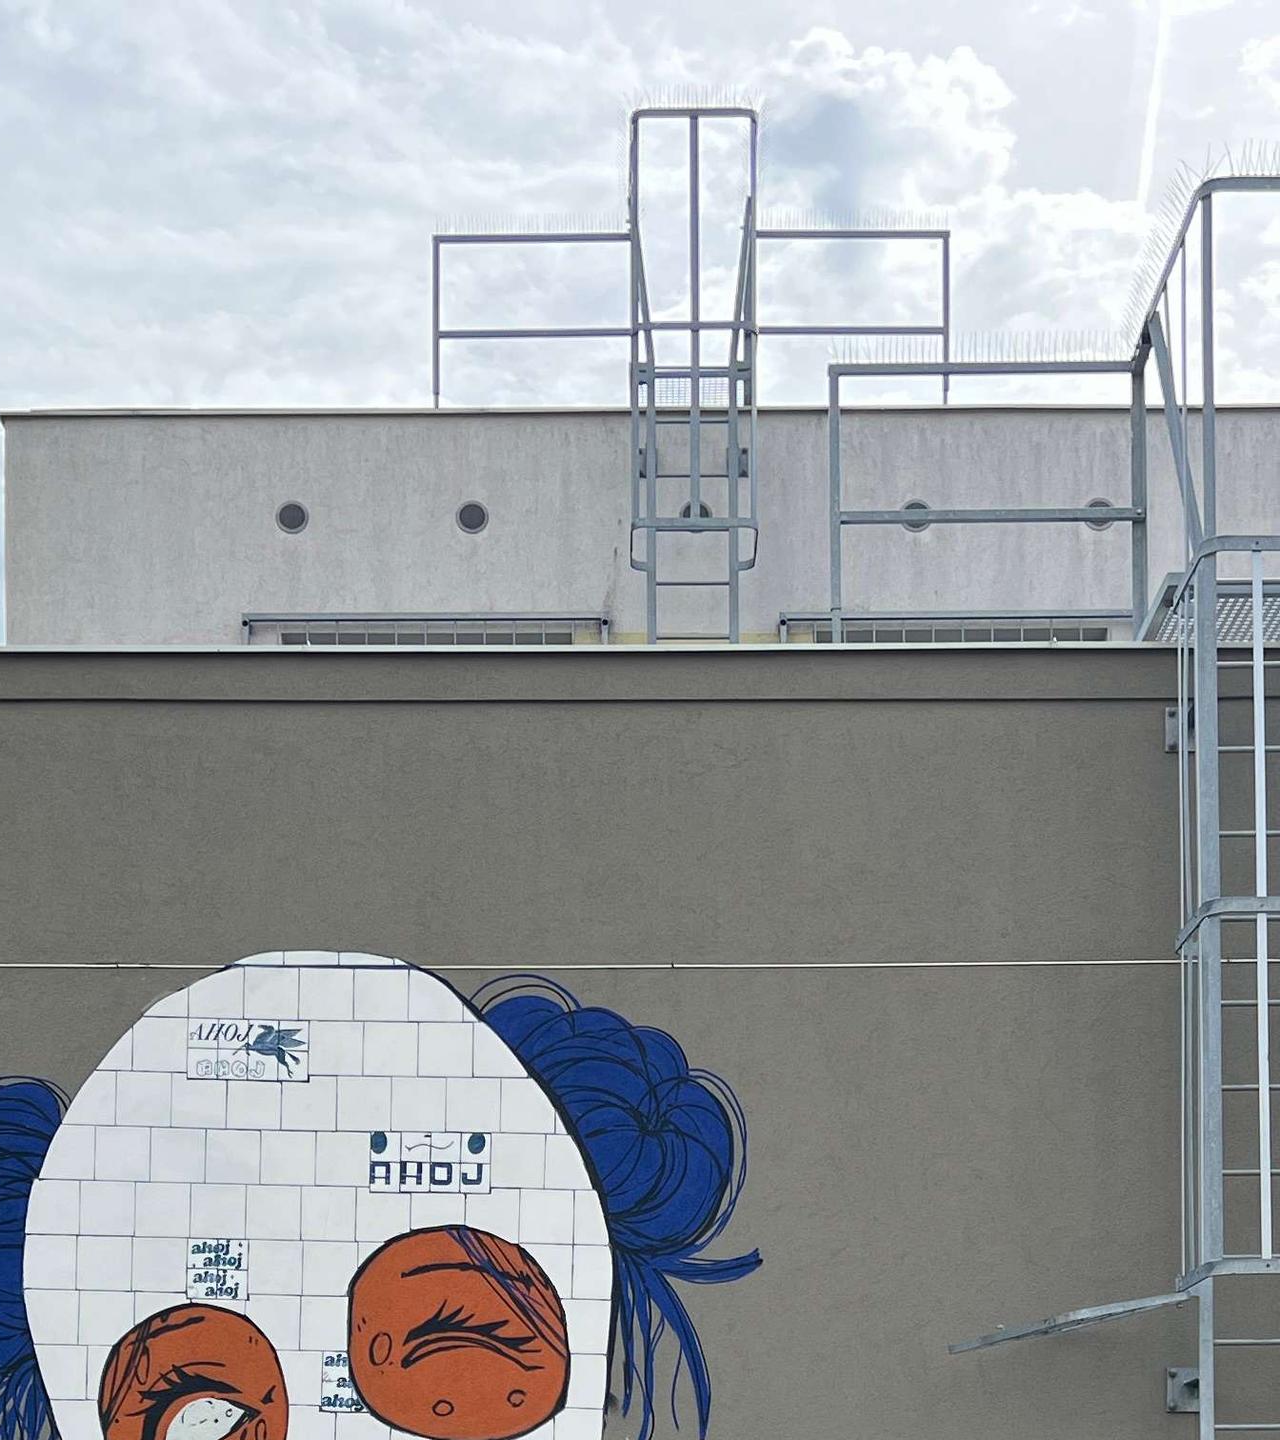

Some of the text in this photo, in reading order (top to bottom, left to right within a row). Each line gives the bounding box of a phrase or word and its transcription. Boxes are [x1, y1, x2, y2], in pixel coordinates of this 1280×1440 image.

[190, 1023, 254, 1042] AHOJ
[196, 1060, 265, 1078] AHOJ
[370, 1161, 483, 1185] AHOJ
[191, 1239, 230, 1256] ahoj
[203, 1252, 243, 1270] ahoj
[193, 1270, 227, 1287] ahoj
